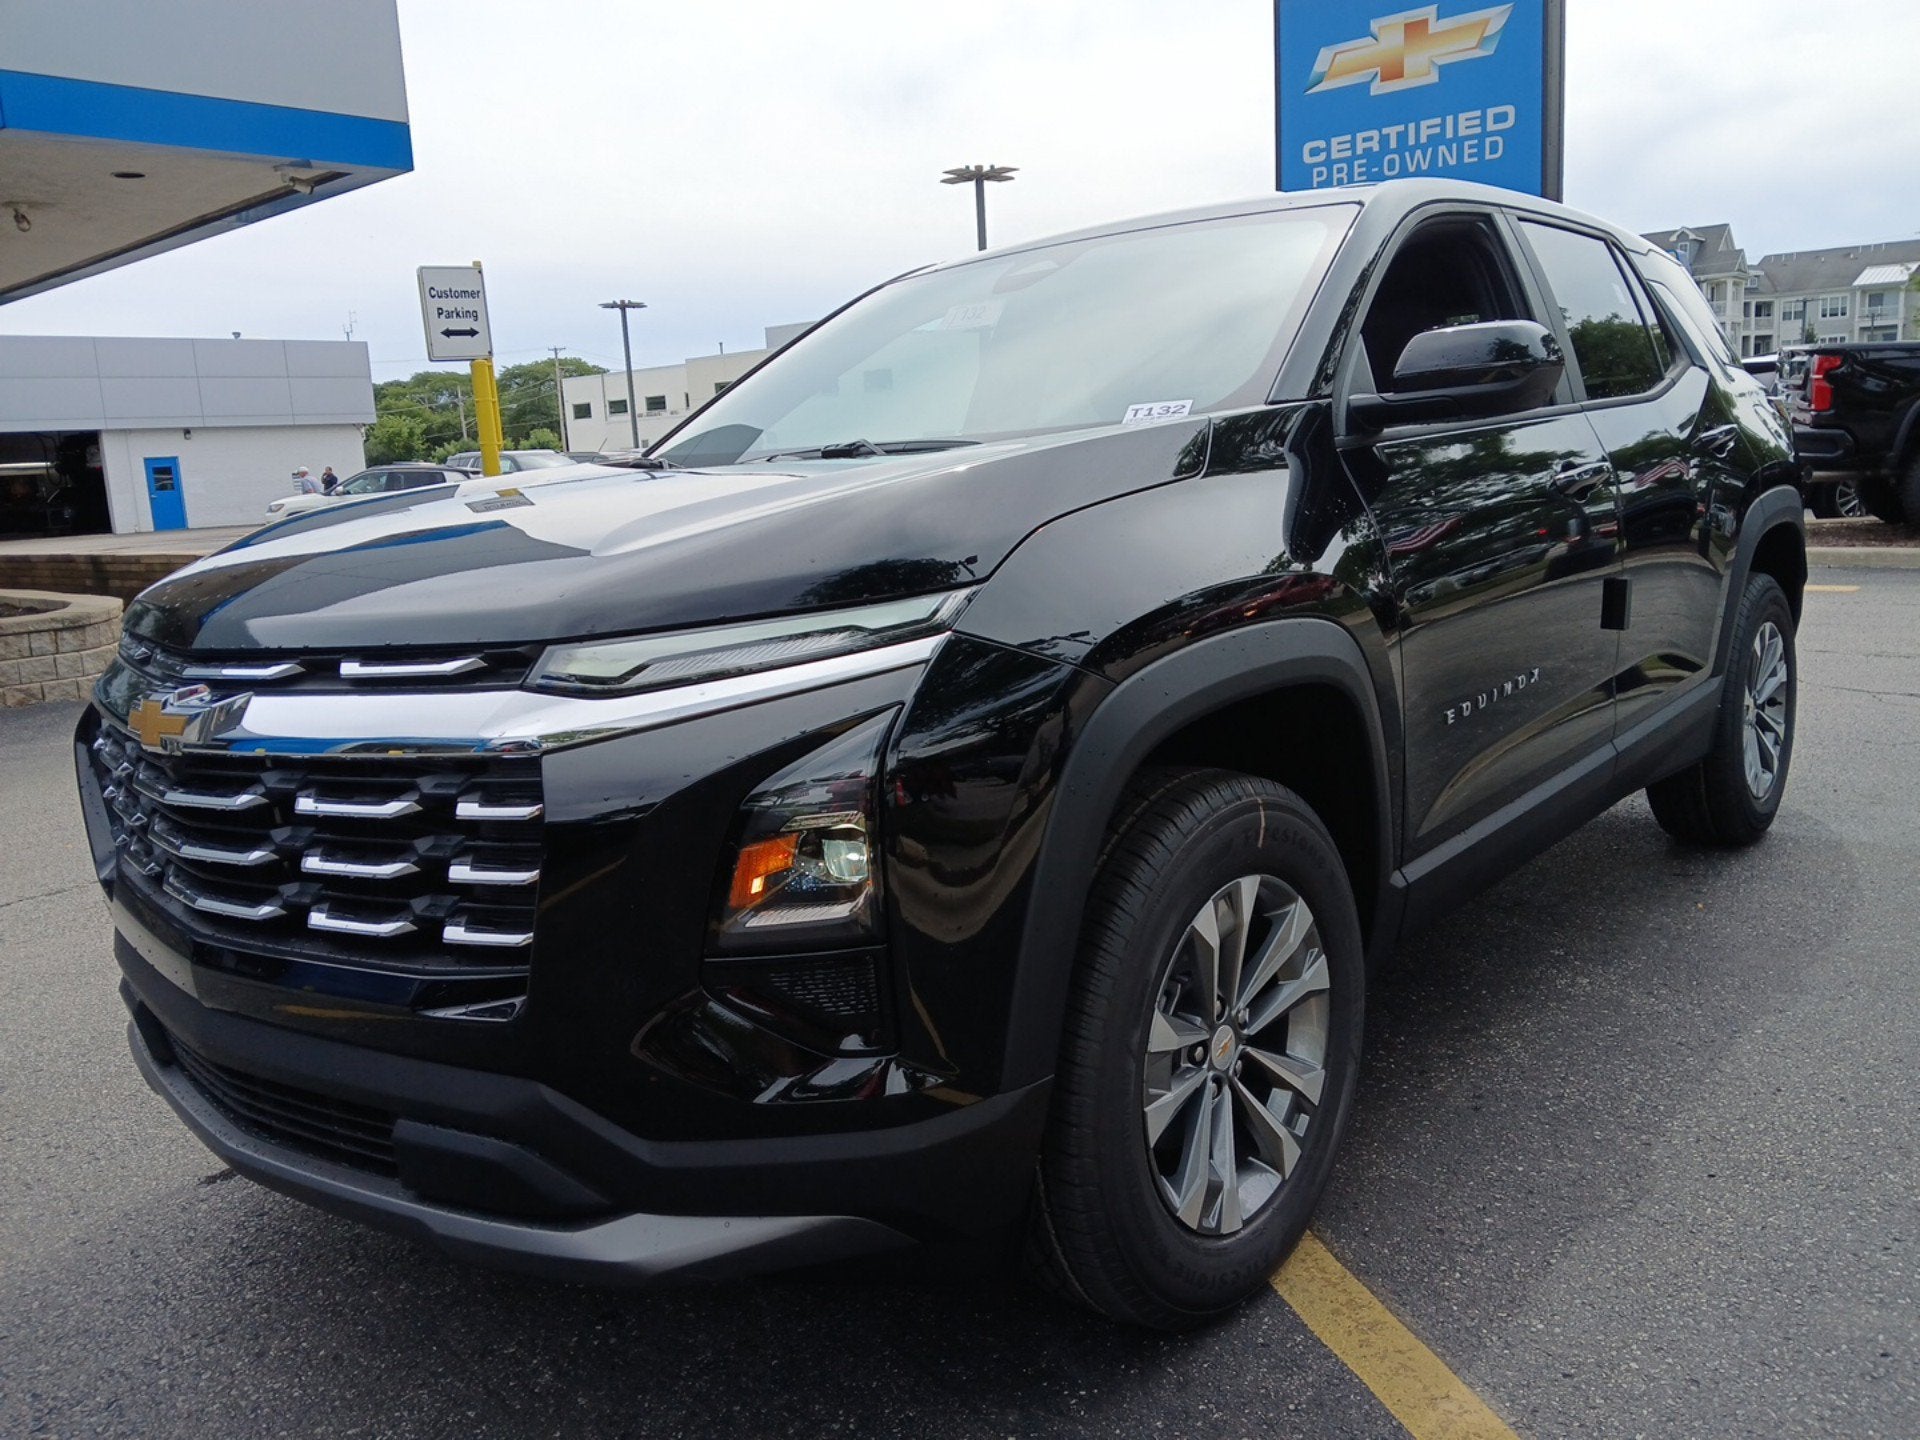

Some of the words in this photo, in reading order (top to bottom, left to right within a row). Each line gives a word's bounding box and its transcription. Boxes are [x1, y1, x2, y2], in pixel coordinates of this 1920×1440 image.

[1302, 104, 1516, 164] CERTIFIED
[1312, 136, 1504, 188] PRE-OWNED
[428, 286, 481, 300] Customer
[436, 306, 479, 322] Parking
[1131, 404, 1187, 418] T132
[1444, 667, 1540, 725] EQUINOX
